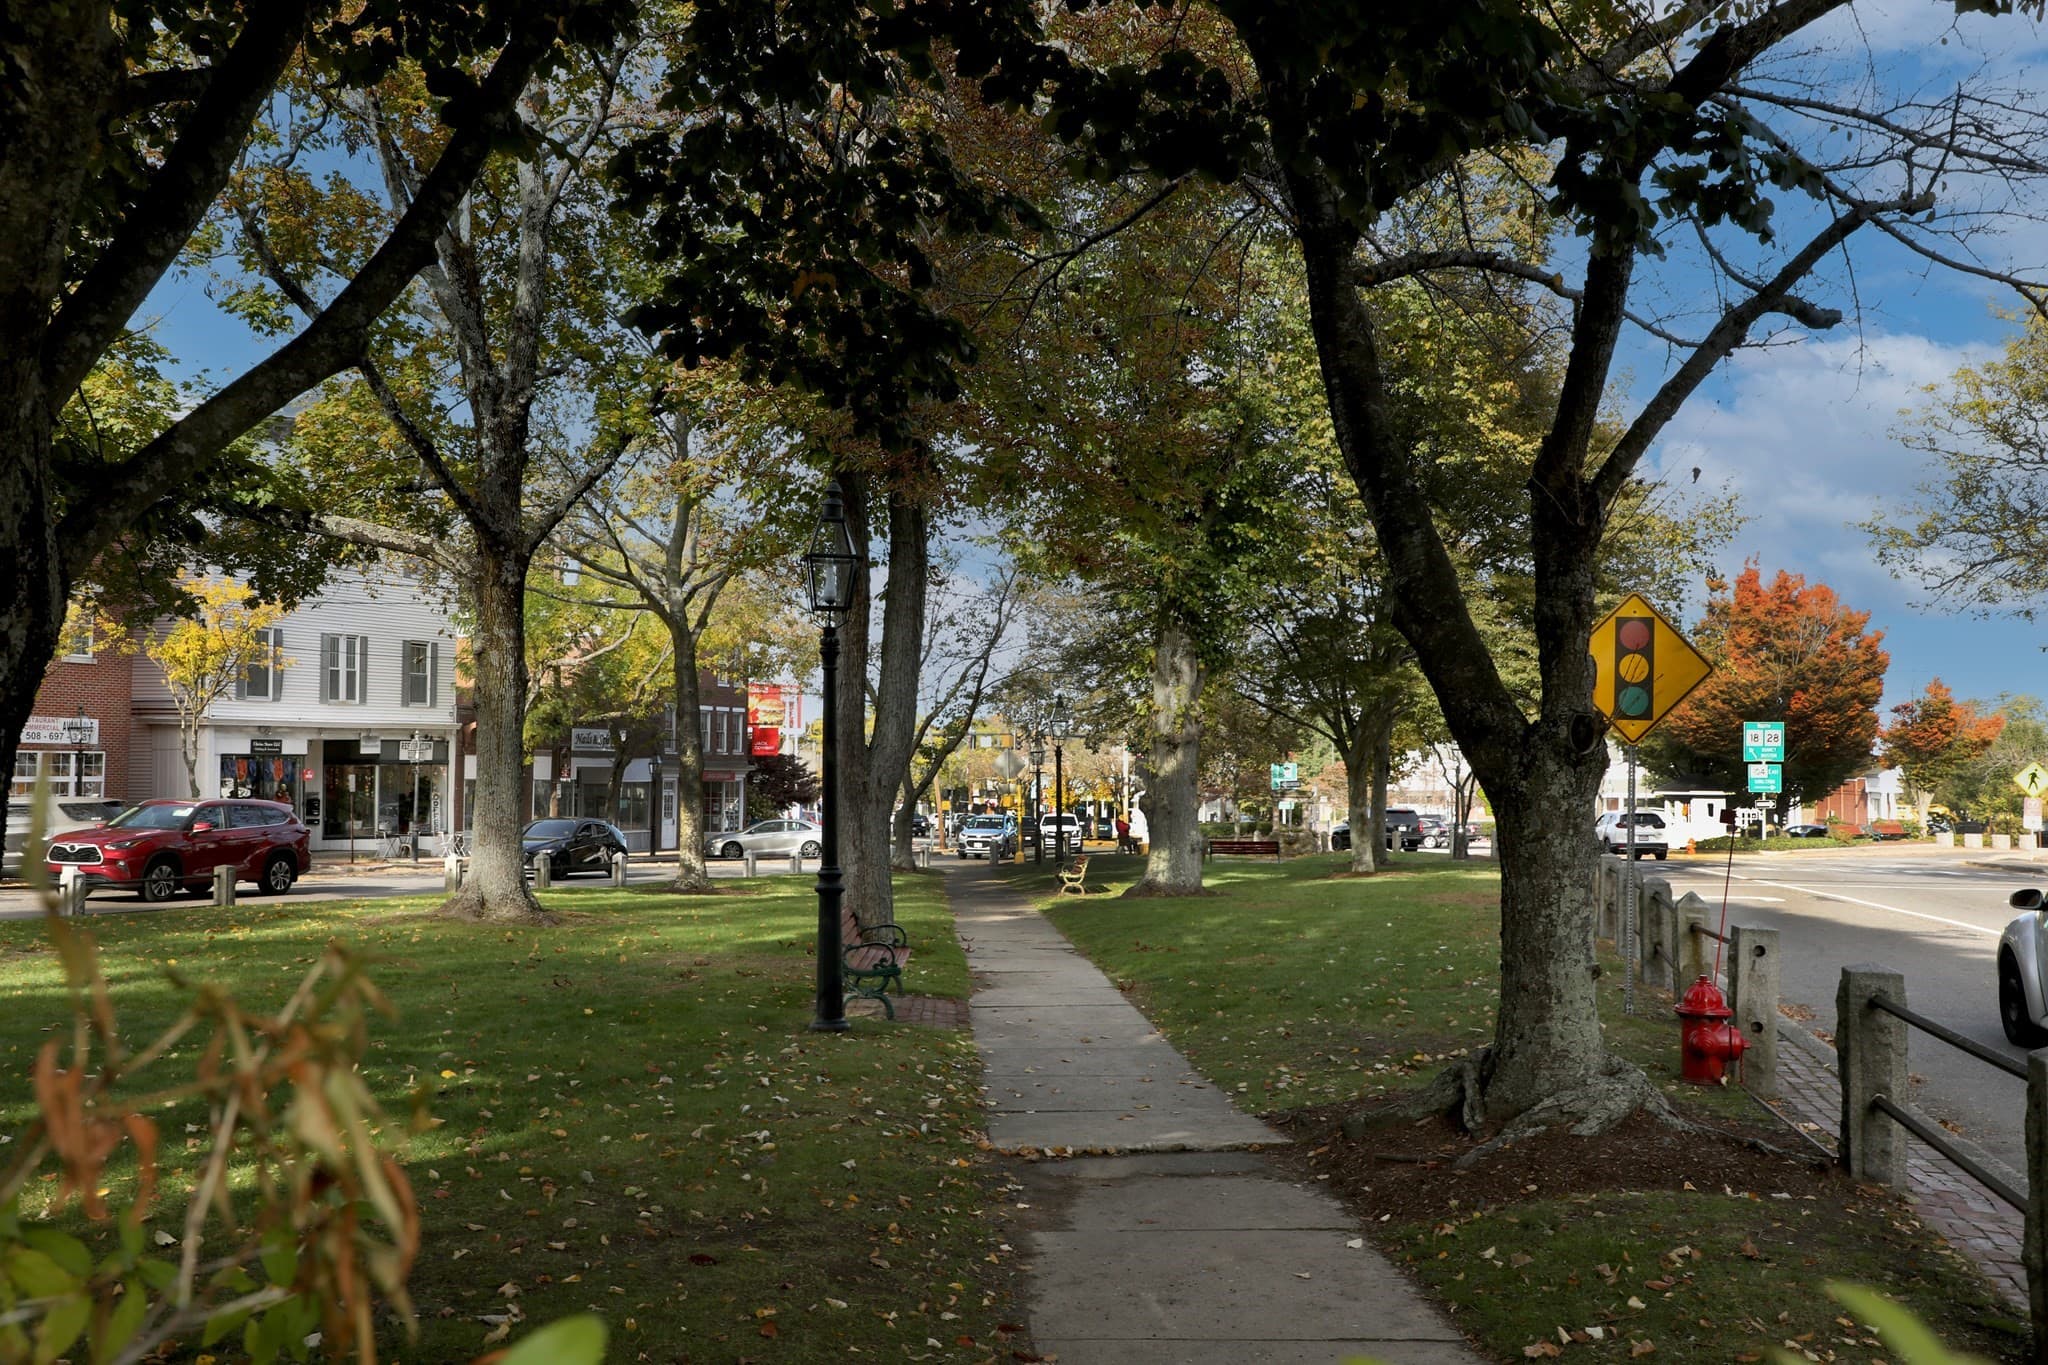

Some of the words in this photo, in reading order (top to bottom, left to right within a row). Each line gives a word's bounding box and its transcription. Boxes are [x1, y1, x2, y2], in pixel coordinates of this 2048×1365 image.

[25, 731, 41, 740] 508
[48, 732, 64, 741] 697
[1750, 733, 1759, 742] 18
[1767, 733, 1779, 743] 28
